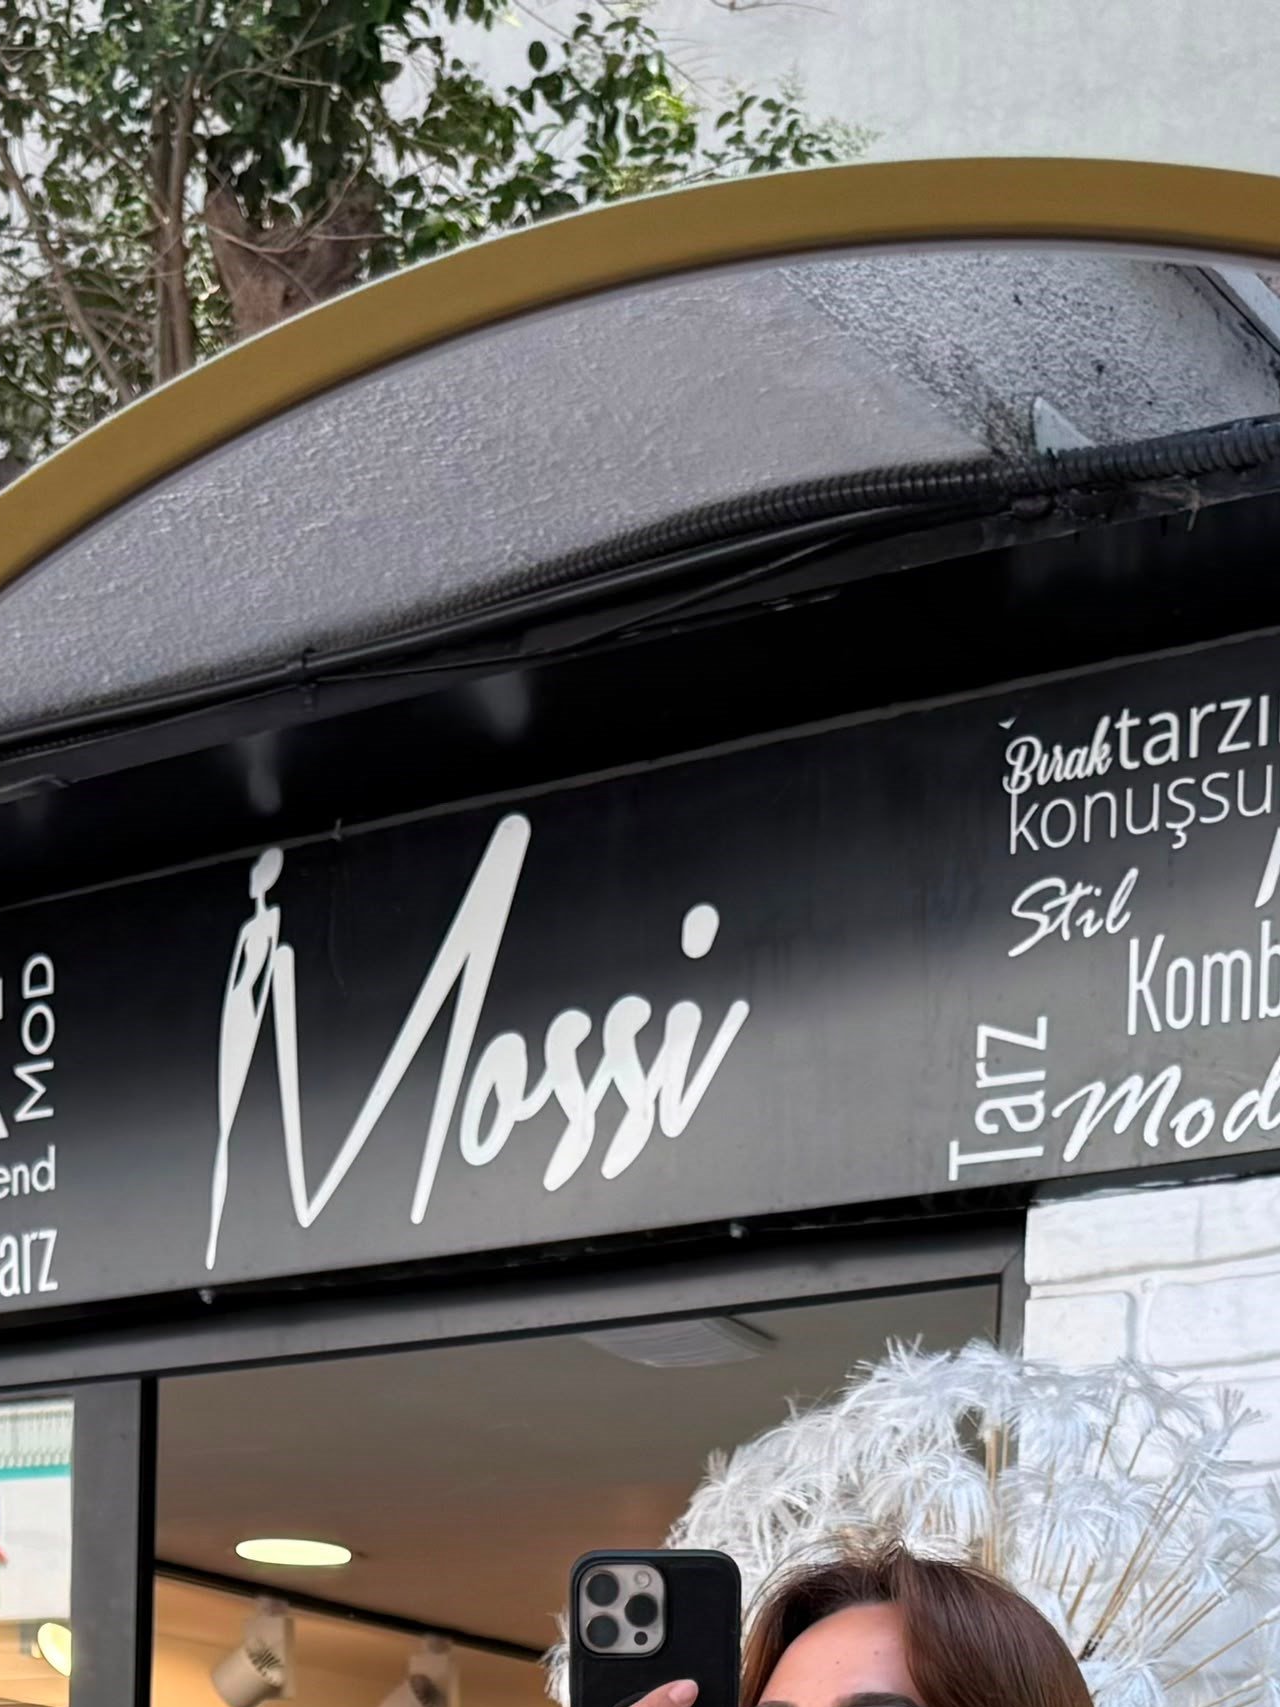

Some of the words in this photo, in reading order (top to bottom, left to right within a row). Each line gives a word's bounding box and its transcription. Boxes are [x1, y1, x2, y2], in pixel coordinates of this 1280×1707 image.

[1004, 716, 1114, 796] Bırak
[1008, 868, 1139, 957] Stil
[14, 954, 55, 1121] MOD
[206, 814, 750, 1270] Mossi
[949, 1014, 1048, 1182] Tarz
